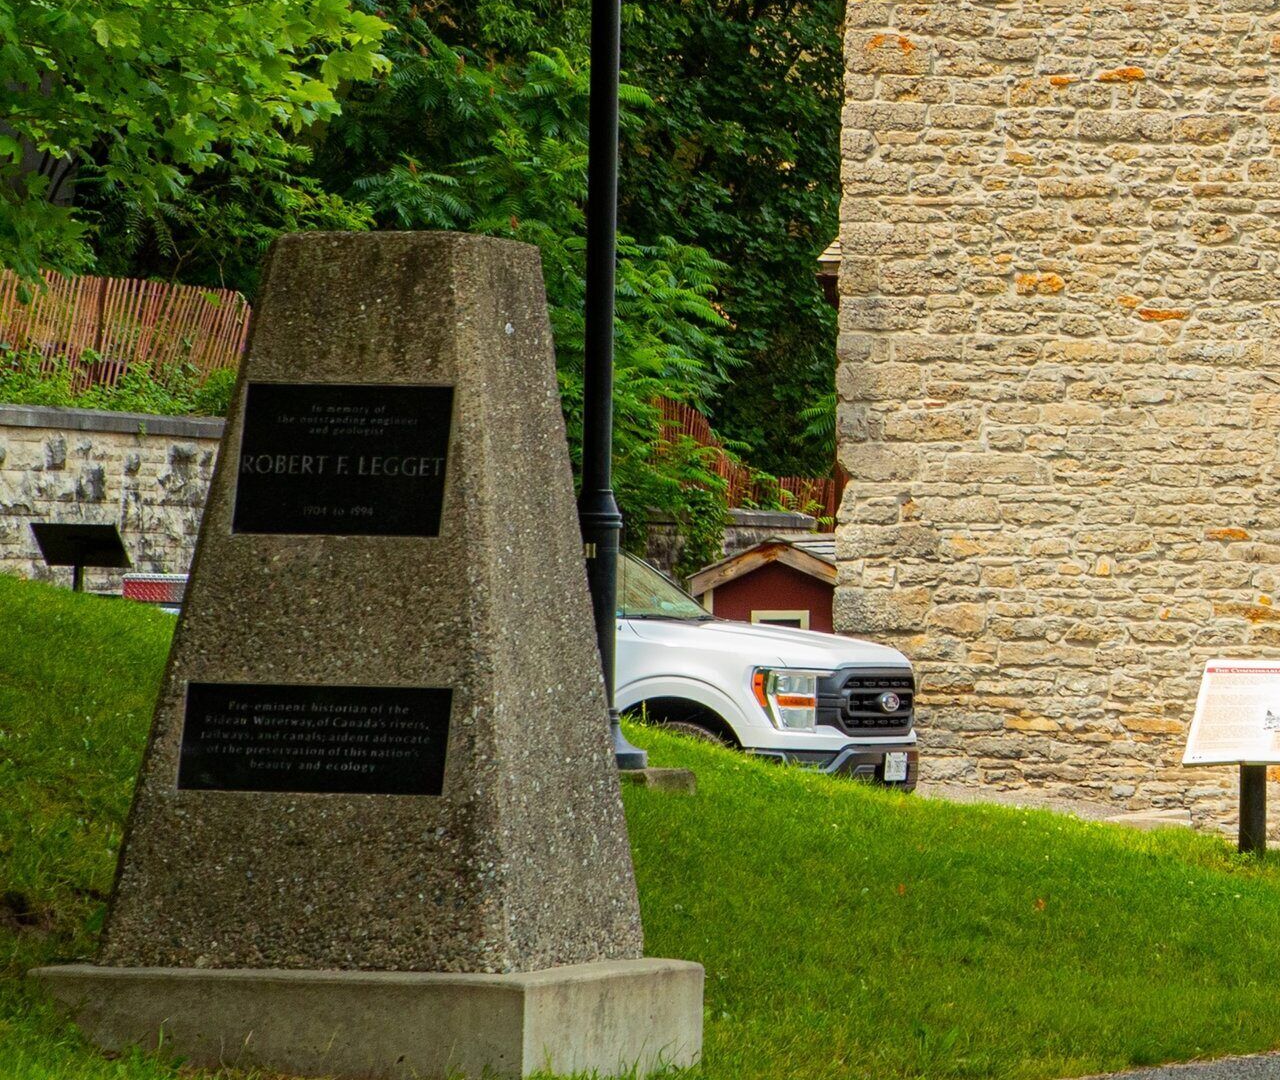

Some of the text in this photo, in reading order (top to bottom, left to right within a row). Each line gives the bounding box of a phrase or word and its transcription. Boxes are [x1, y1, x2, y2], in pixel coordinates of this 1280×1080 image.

[327, 406, 368, 414] memory
[375, 405, 386, 413] of
[300, 416, 366, 426] outstanding
[309, 426, 384, 436] and geologist
[241, 455, 445, 475] ROBERT F. LEGGET
[333, 505, 344, 516] to
[228, 701, 410, 715] Pre-eminent historian of the
[332, 717, 386, 729] Canada's
[257, 730, 280, 741] and
[328, 733, 369, 743] ardent
[373, 734, 431, 745] advocate
[222, 744, 242, 754] the
[245, 745, 325, 757] preservation
[328, 747, 341, 756] of
[343, 747, 367, 757] this
[250, 759, 376, 774] beauty and ecology
